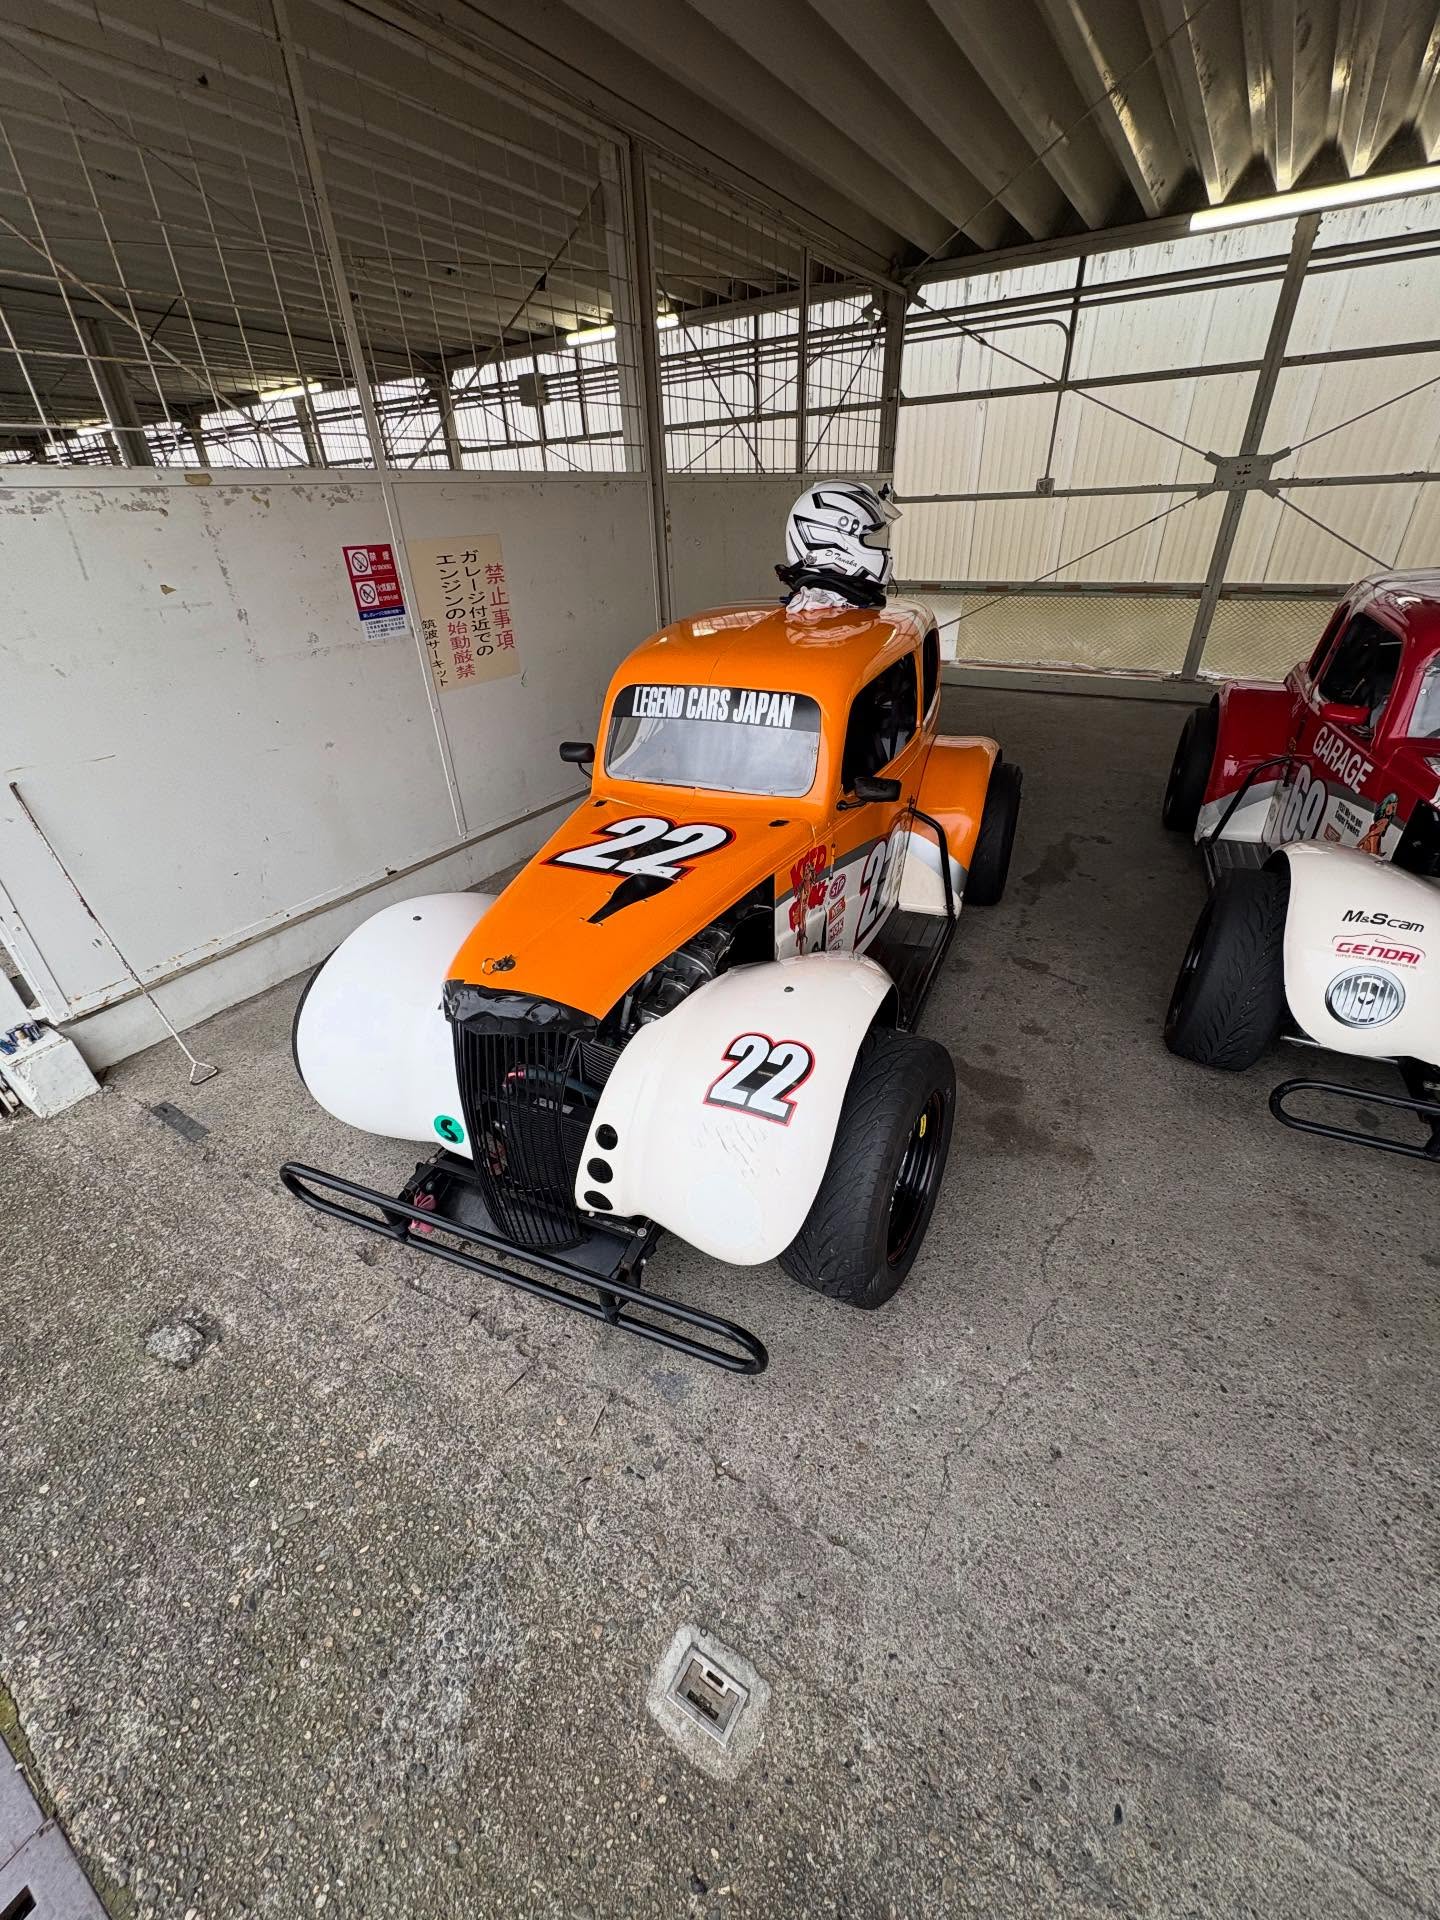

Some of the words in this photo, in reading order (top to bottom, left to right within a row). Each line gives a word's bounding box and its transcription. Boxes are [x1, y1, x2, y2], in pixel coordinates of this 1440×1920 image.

[435, 554, 476, 679] エンジンの始動厳禁
[460, 549, 494, 656] ガレージ付近での
[484, 562, 515, 650] 禁止事項
[420, 619, 448, 687] 筑波サーキット
[631, 685, 684, 718] LEGEND
[685, 689, 729, 722] CARS
[731, 692, 796, 728] JAPAN
[1312, 726, 1374, 794] GARAGE
[1281, 762, 1328, 842] 69
[545, 817, 736, 879] 22
[1336, 942, 1421, 965] GENDAI
[703, 1032, 815, 1127] 22
[438, 1119, 457, 1142] S
